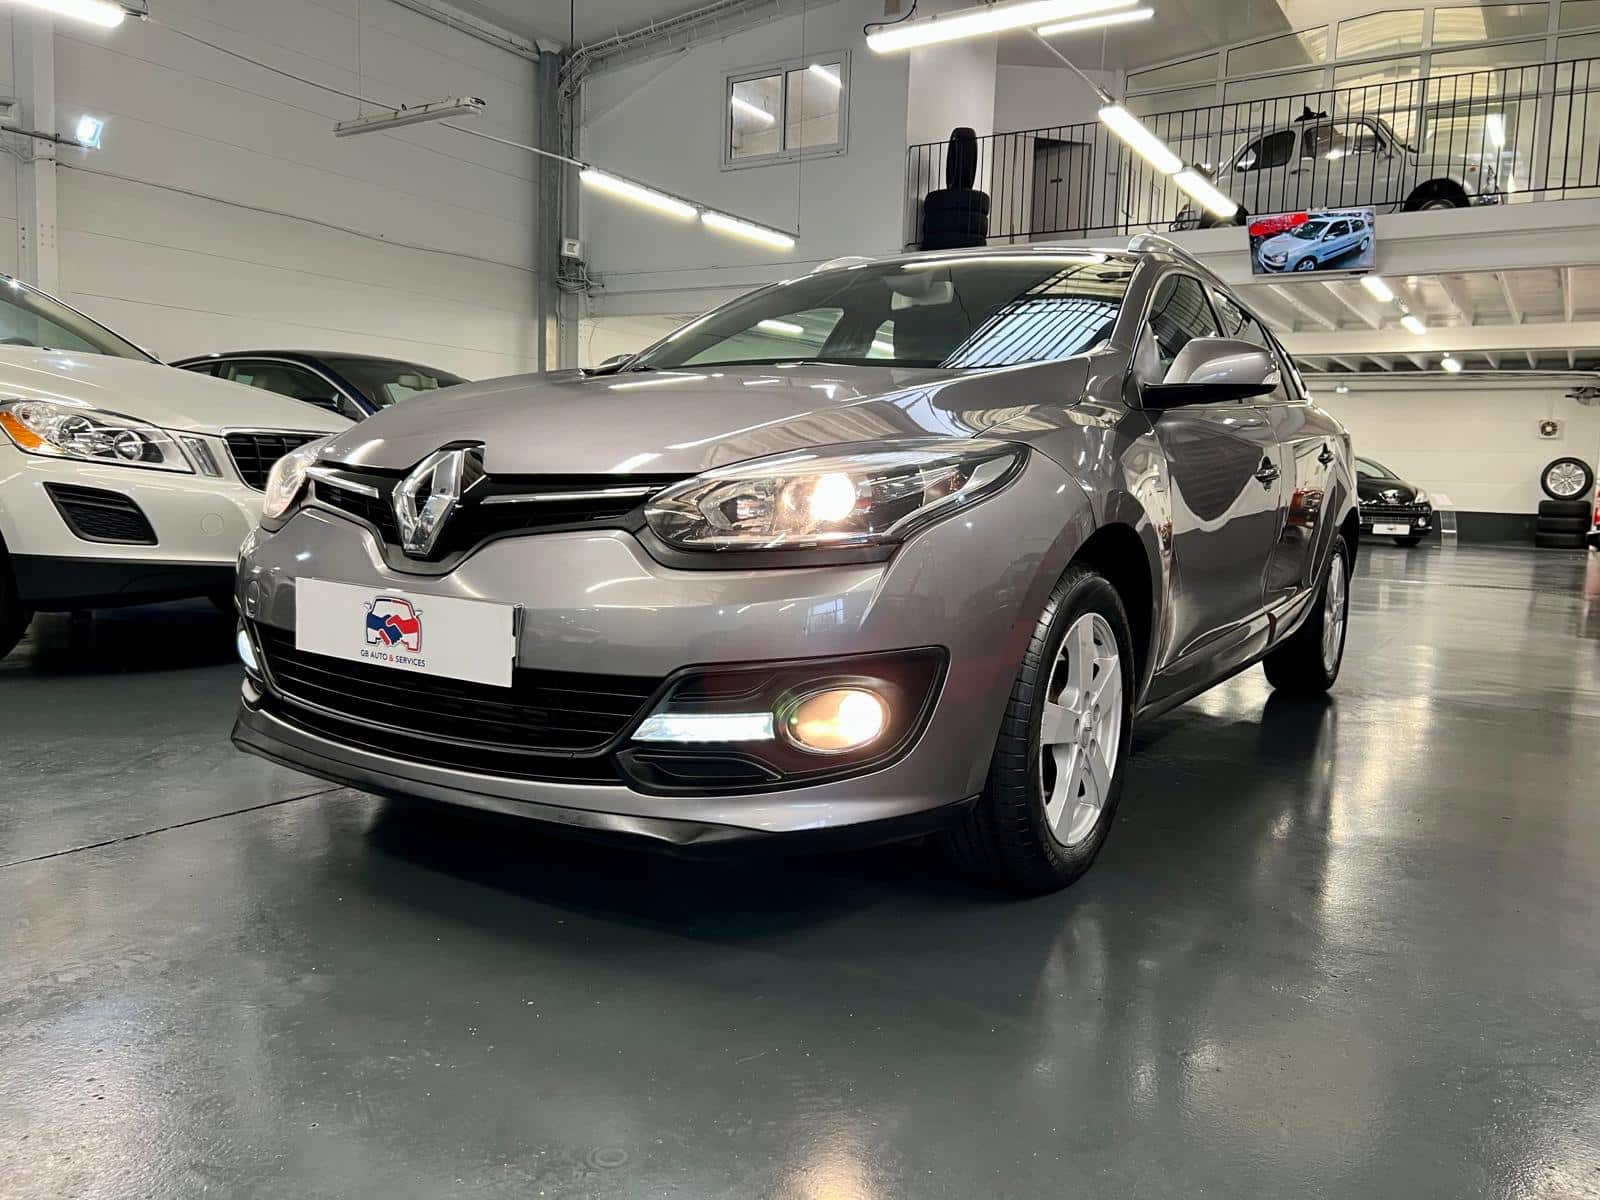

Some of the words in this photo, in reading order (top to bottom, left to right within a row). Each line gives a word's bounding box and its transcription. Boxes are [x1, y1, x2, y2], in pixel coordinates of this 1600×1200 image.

[360, 649, 369, 657] GB
[370, 651, 388, 660] AUTO
[388, 654, 394, 662] &
[395, 655, 426, 667] SERVICES
